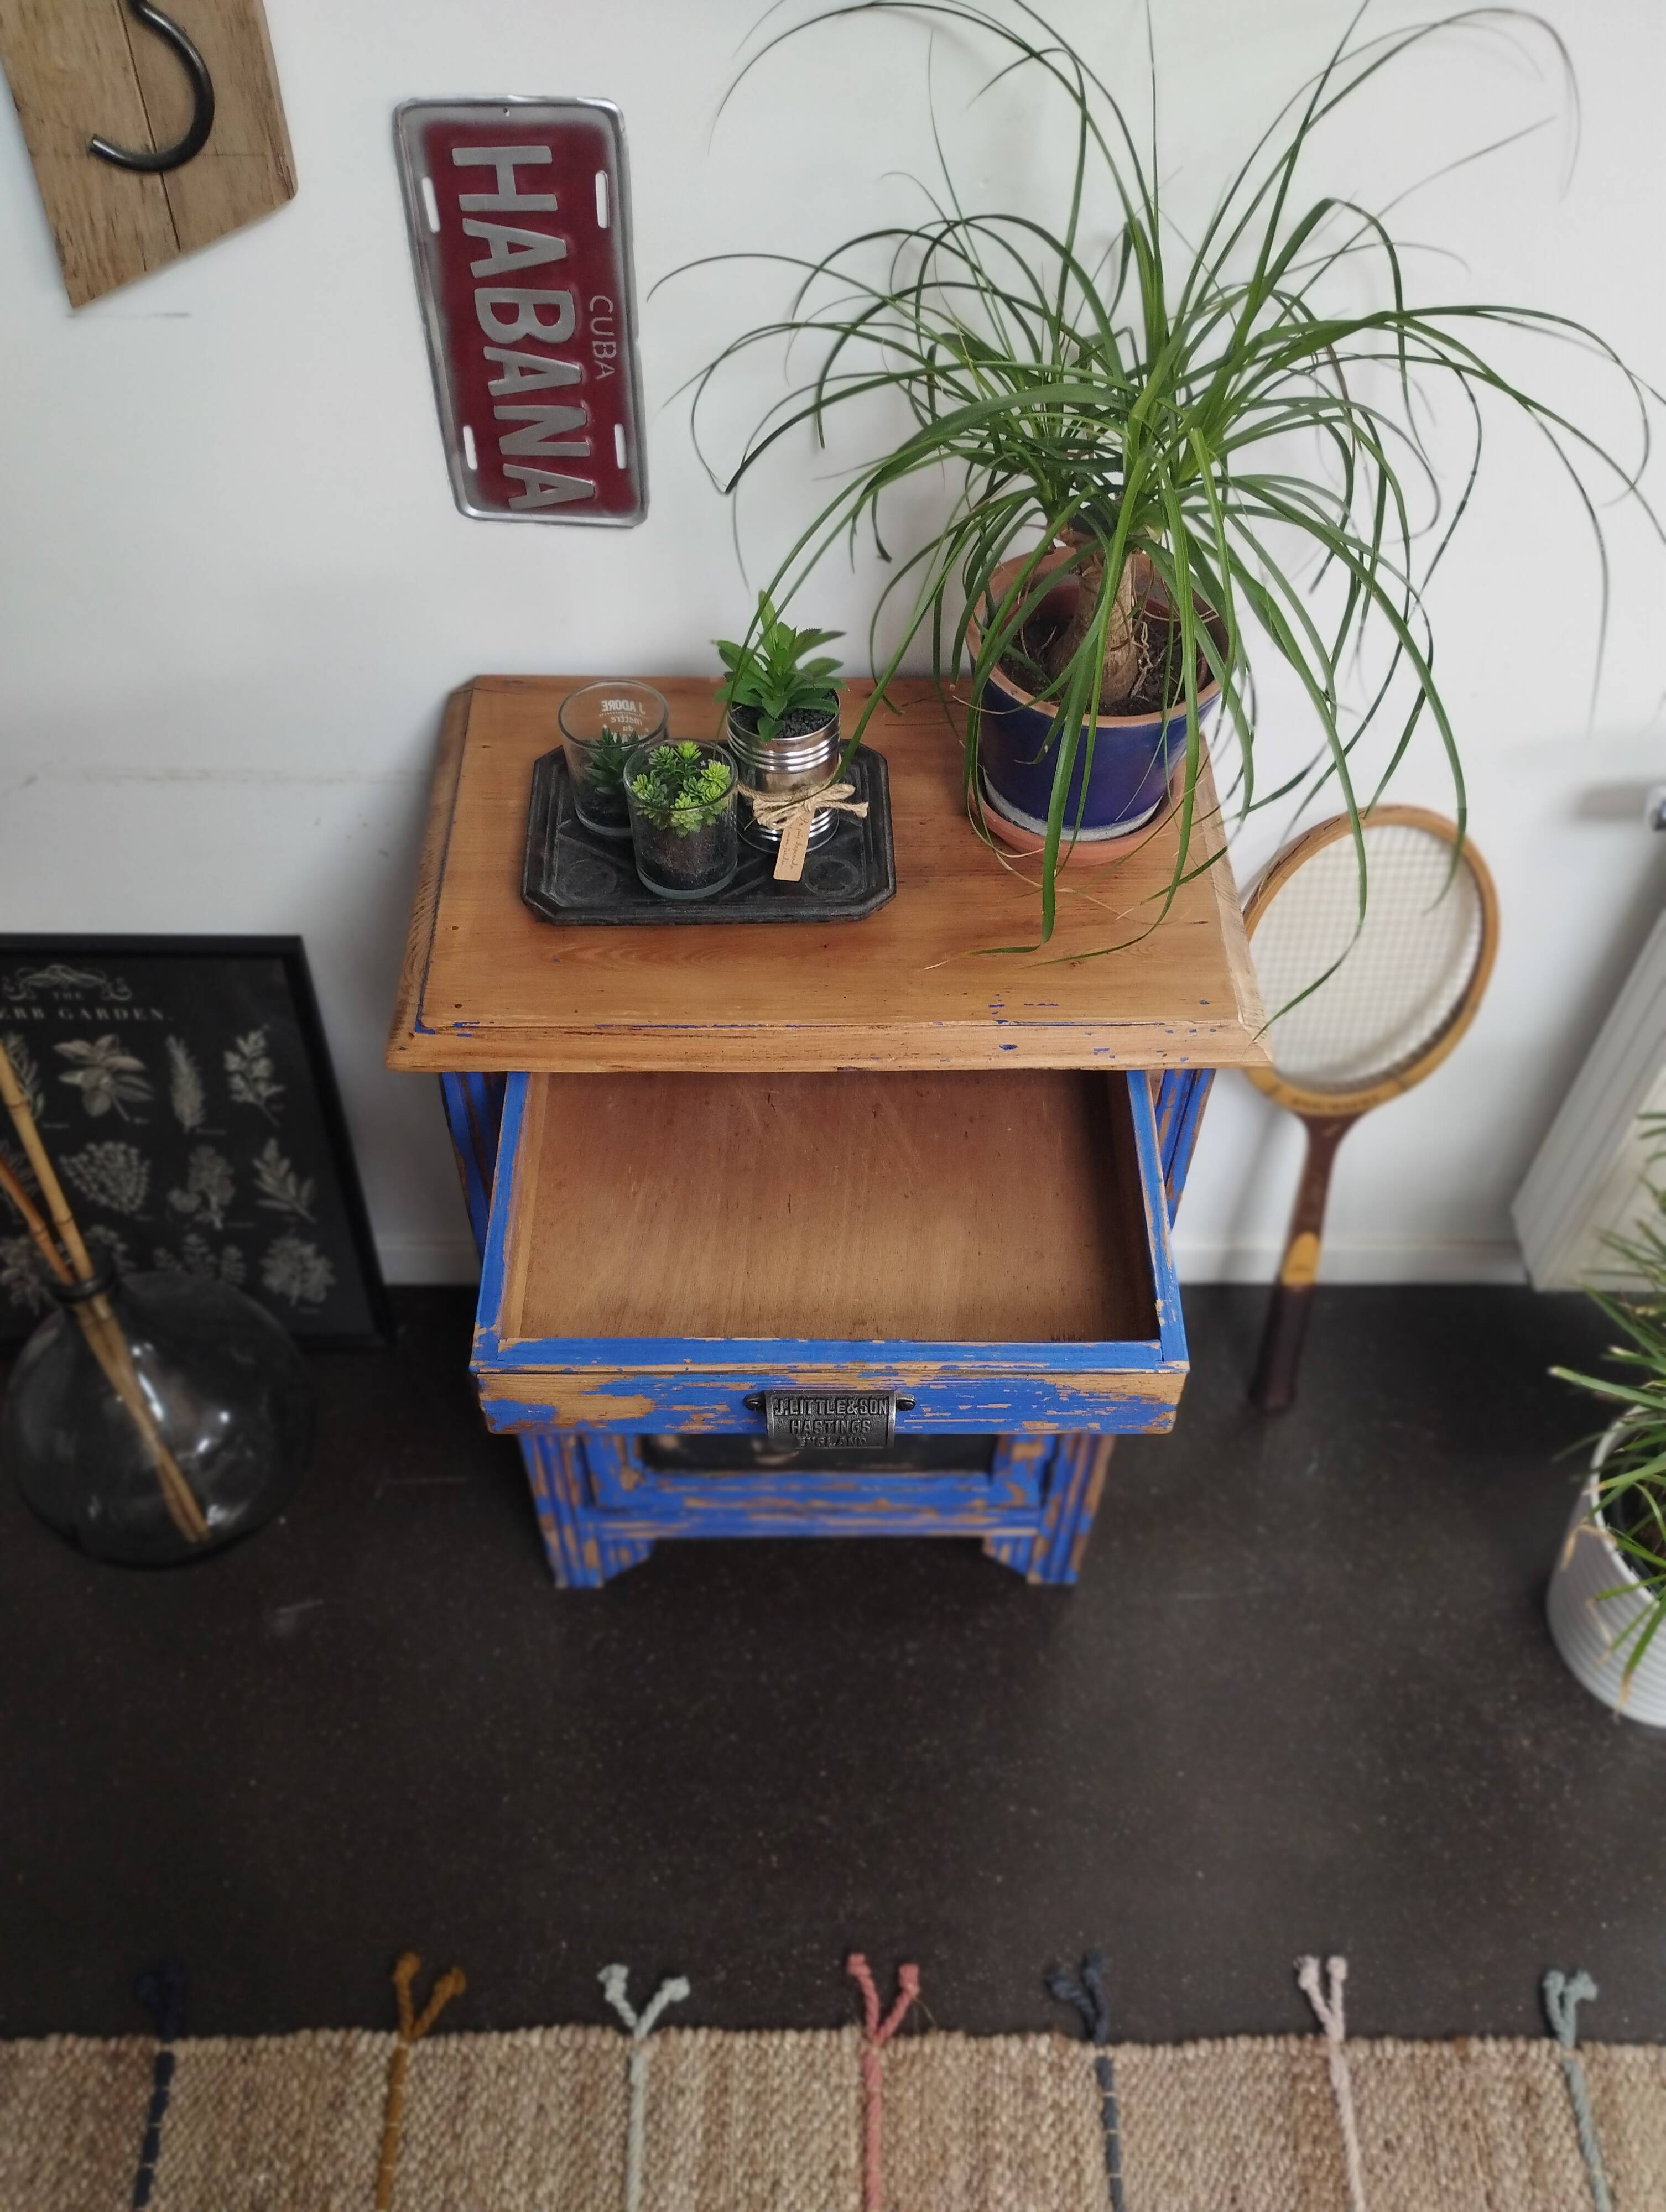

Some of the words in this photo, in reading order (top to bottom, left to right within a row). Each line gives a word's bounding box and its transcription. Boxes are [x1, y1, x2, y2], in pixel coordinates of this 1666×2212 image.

[451, 145, 596, 510] HABANA
[589, 294, 618, 381] CUBA
[58, 1008, 166, 1020] GARDEN
[791, 1419, 872, 1434] HASTINGS
